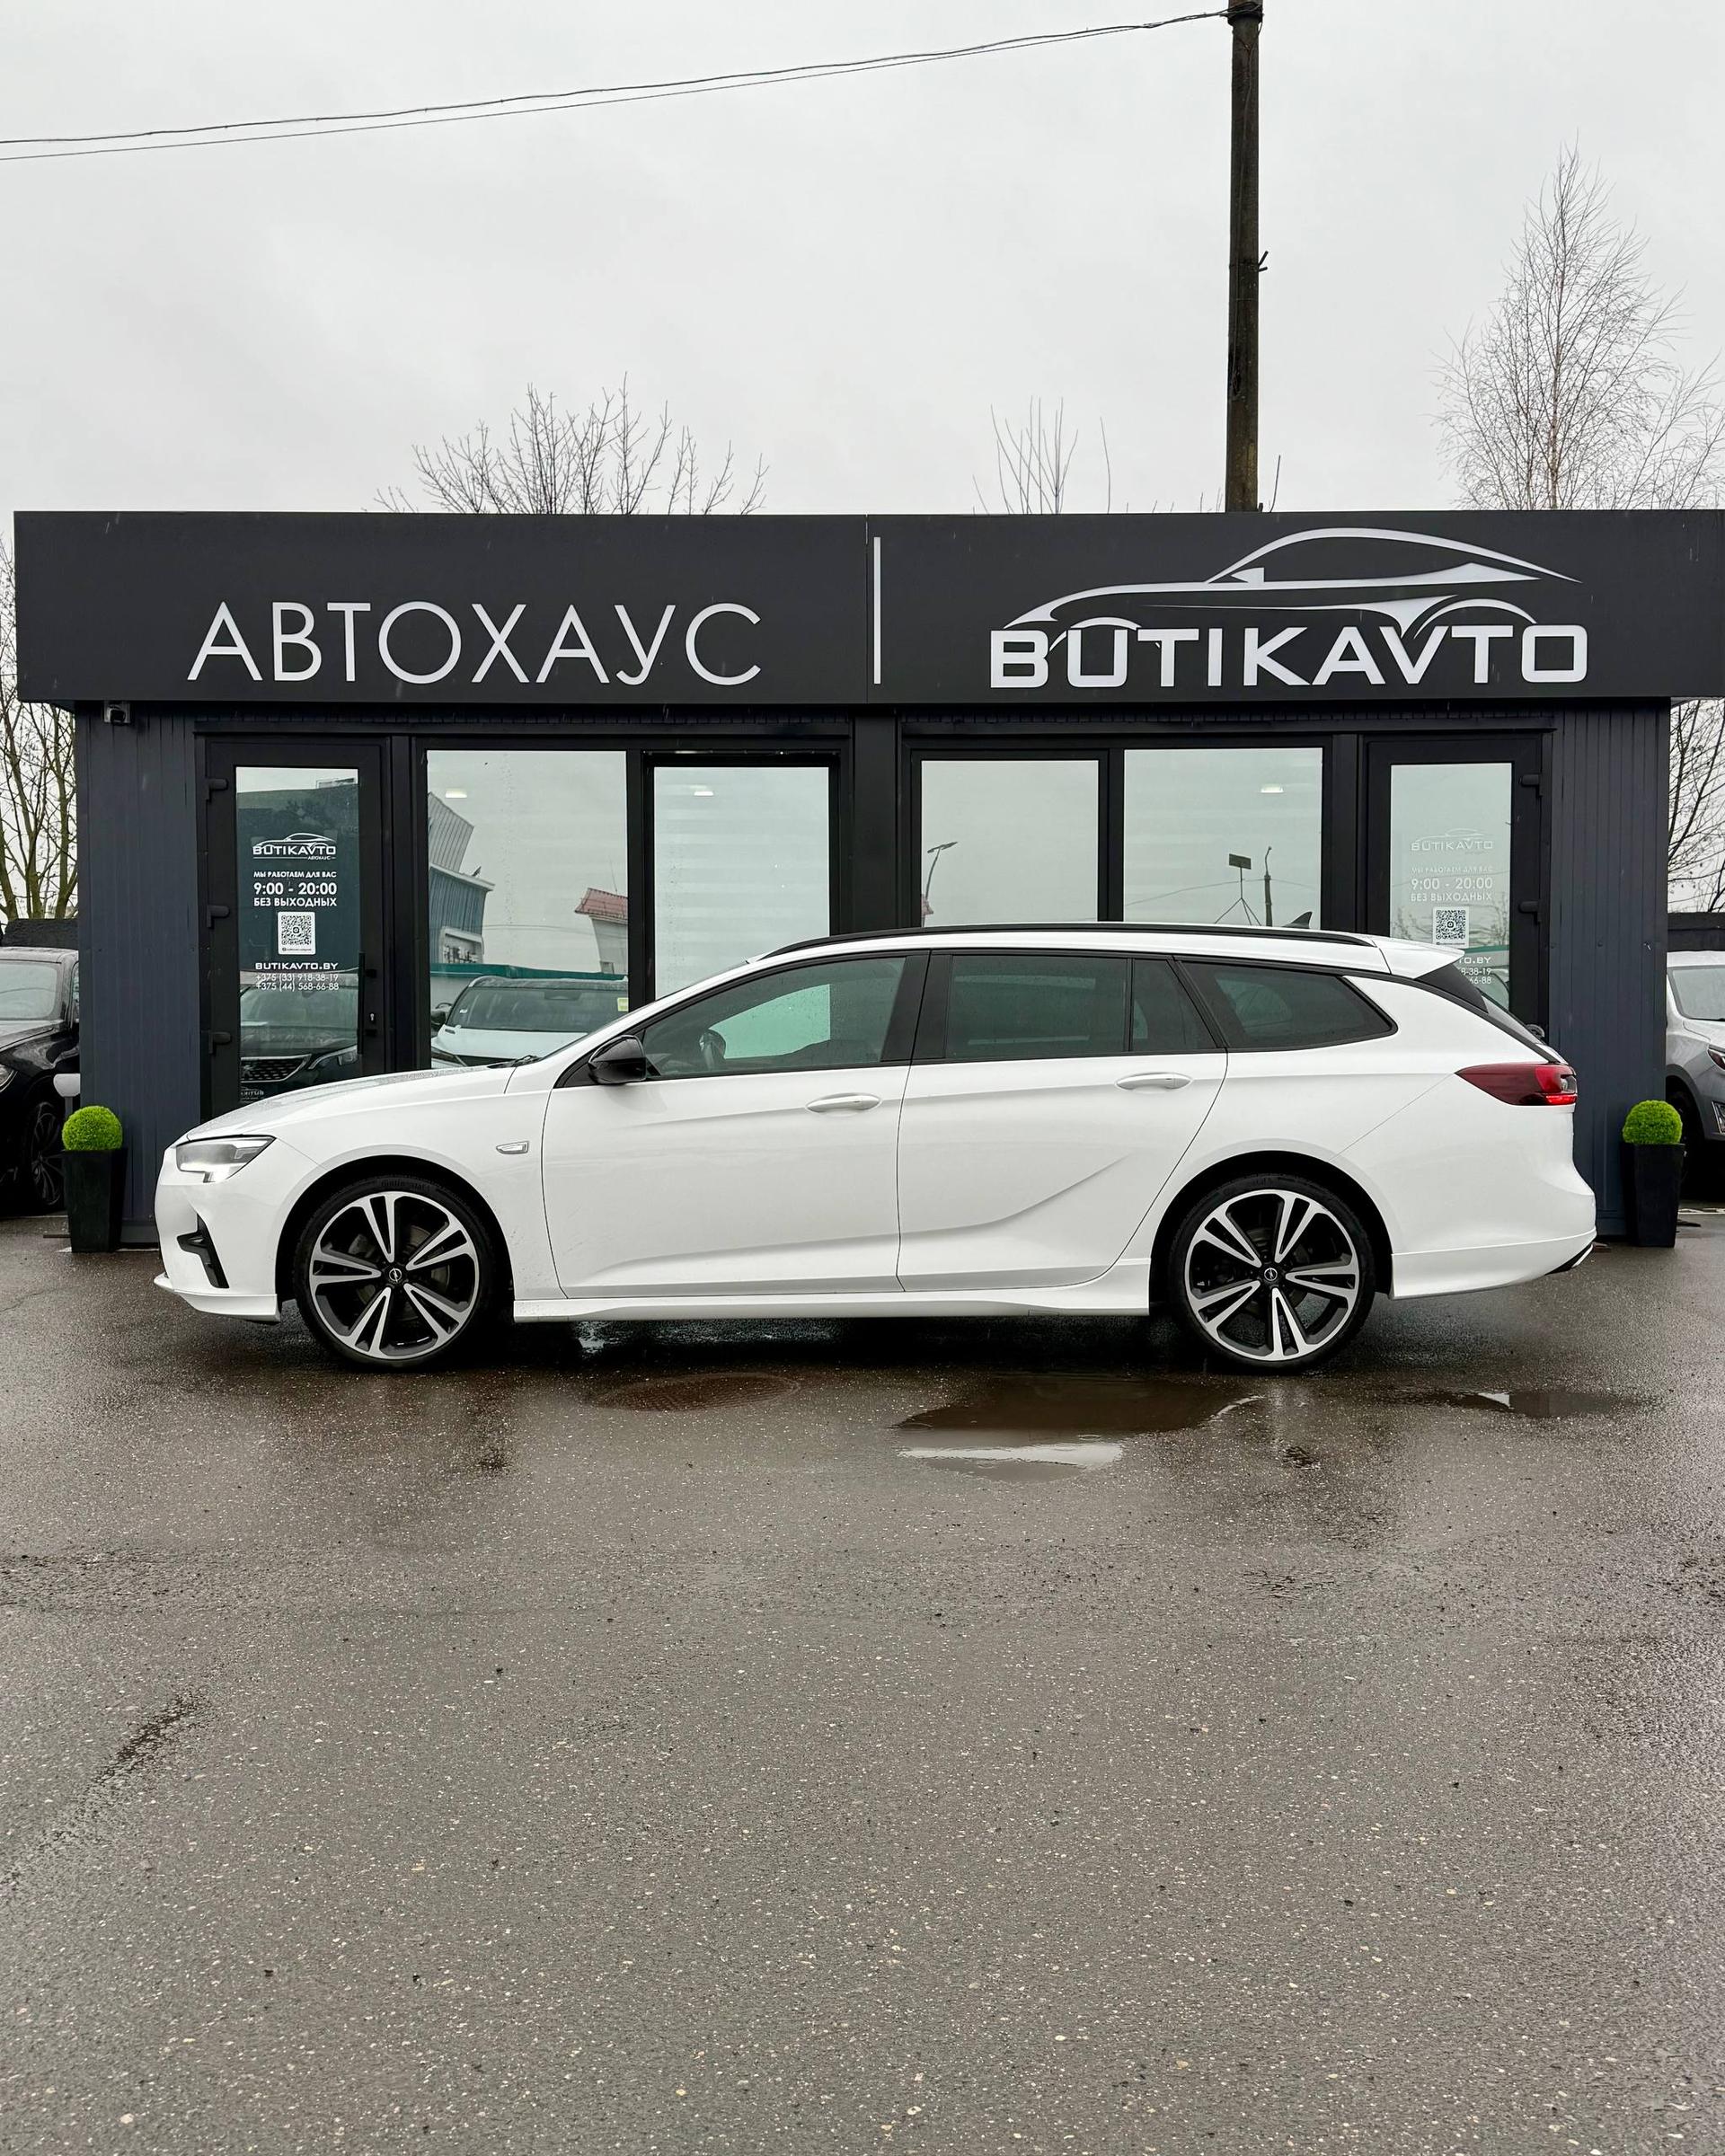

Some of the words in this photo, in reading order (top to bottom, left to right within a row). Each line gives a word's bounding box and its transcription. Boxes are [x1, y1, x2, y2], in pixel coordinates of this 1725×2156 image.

[187, 601, 761, 685] АВТОХАУС
[990, 624, 1588, 688] BUTIKAVTO
[252, 845, 337, 855] BUTIKAVTO
[1411, 841, 1493, 851] BUTIKAVTO
[253, 882, 284, 895] 9:00
[297, 882, 337, 895] 20:00
[1411, 878, 1440, 890] 9:00
[1455, 877, 1493, 889] 20:00
[253, 897, 270, 906] БЕЗ
[274, 897, 337, 907] ВЫХОДНЫХ
[1411, 893, 1427, 902] БЕЗ
[1430, 891, 1492, 901] ВЫХОДНЫХ
[1461, 968, 1491, 976] 8-38-19
[256, 973, 277, 982] +375
[279, 973, 295, 984] (33)
[297, 973, 338, 982] 918-38-19
[256, 982, 277, 991] +375
[279, 982, 295, 992] (44)
[297, 982, 339, 991] 568-66-88
